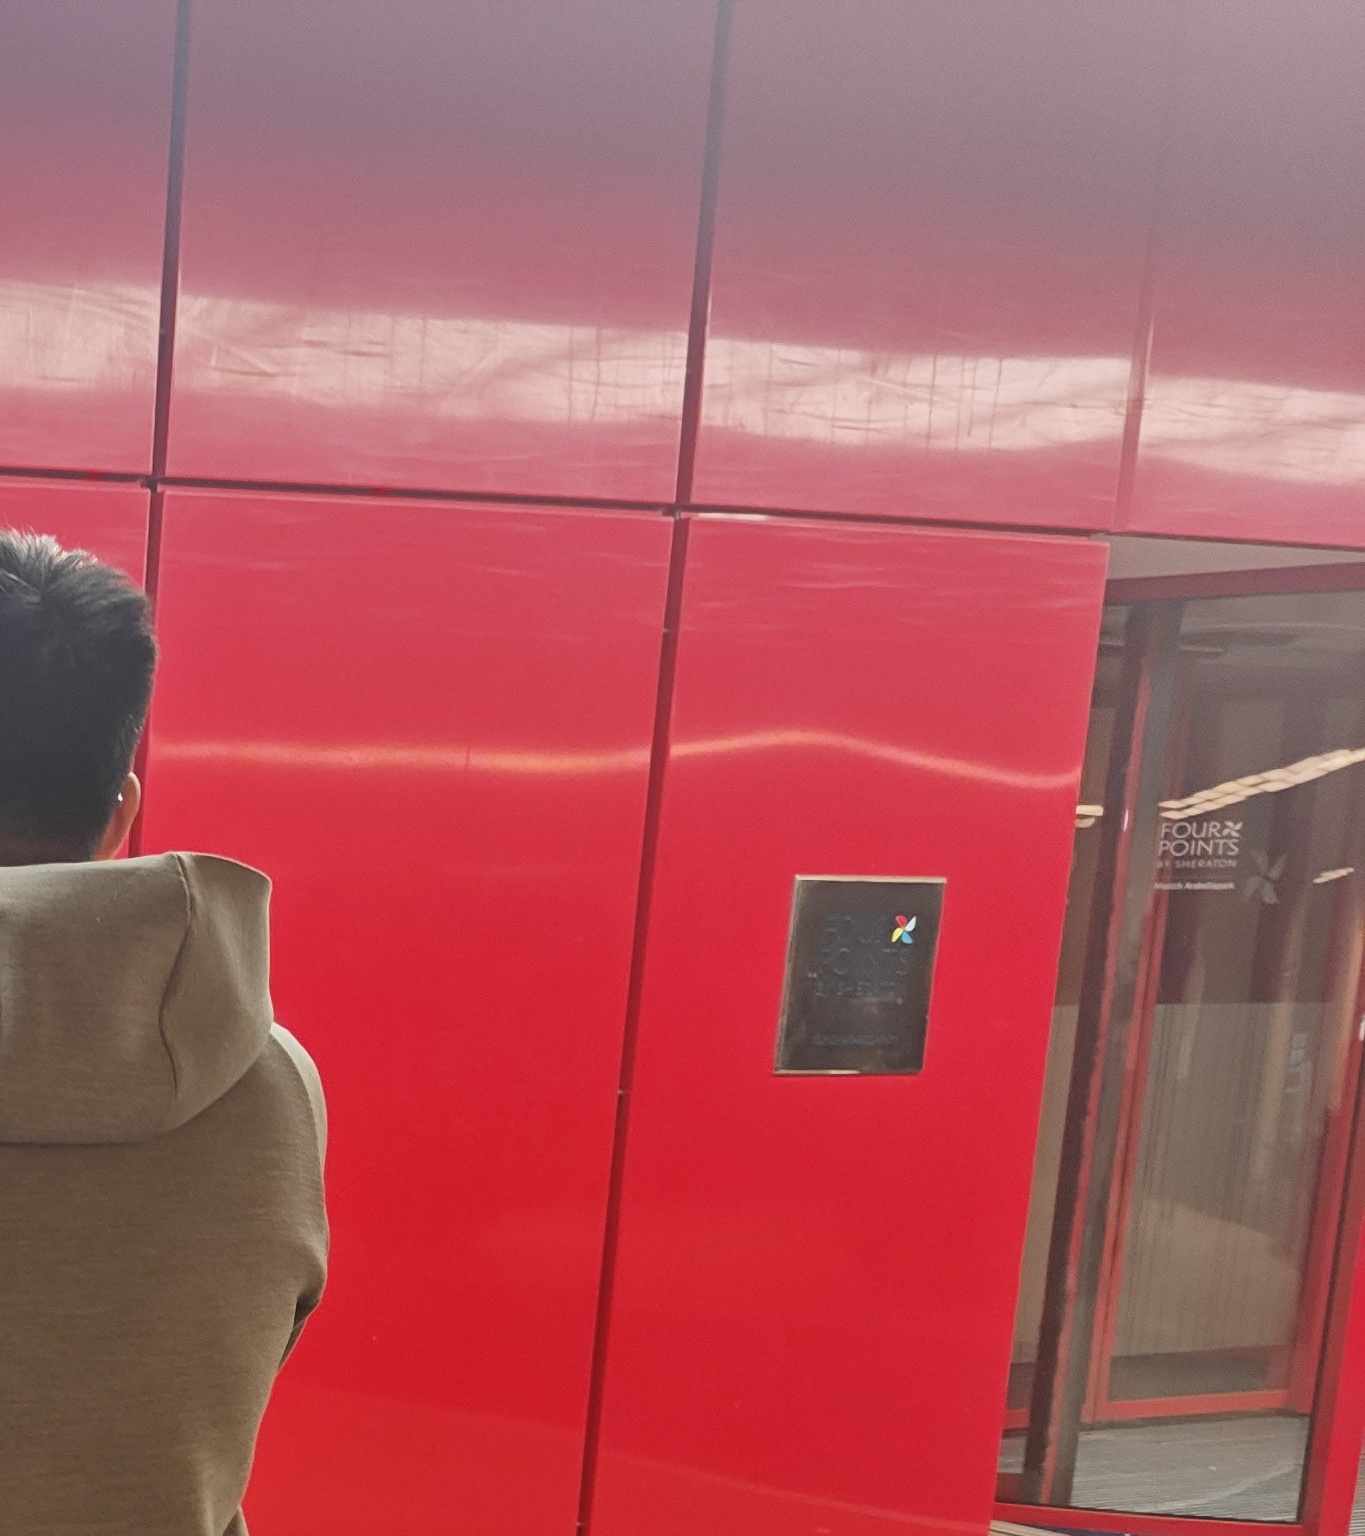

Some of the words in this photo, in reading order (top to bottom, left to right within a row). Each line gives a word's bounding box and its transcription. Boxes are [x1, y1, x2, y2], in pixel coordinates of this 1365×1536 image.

[1161, 821, 1222, 838] FOUR
[1158, 839, 1240, 857] POINTS
[1175, 859, 1238, 869] SHERATON
